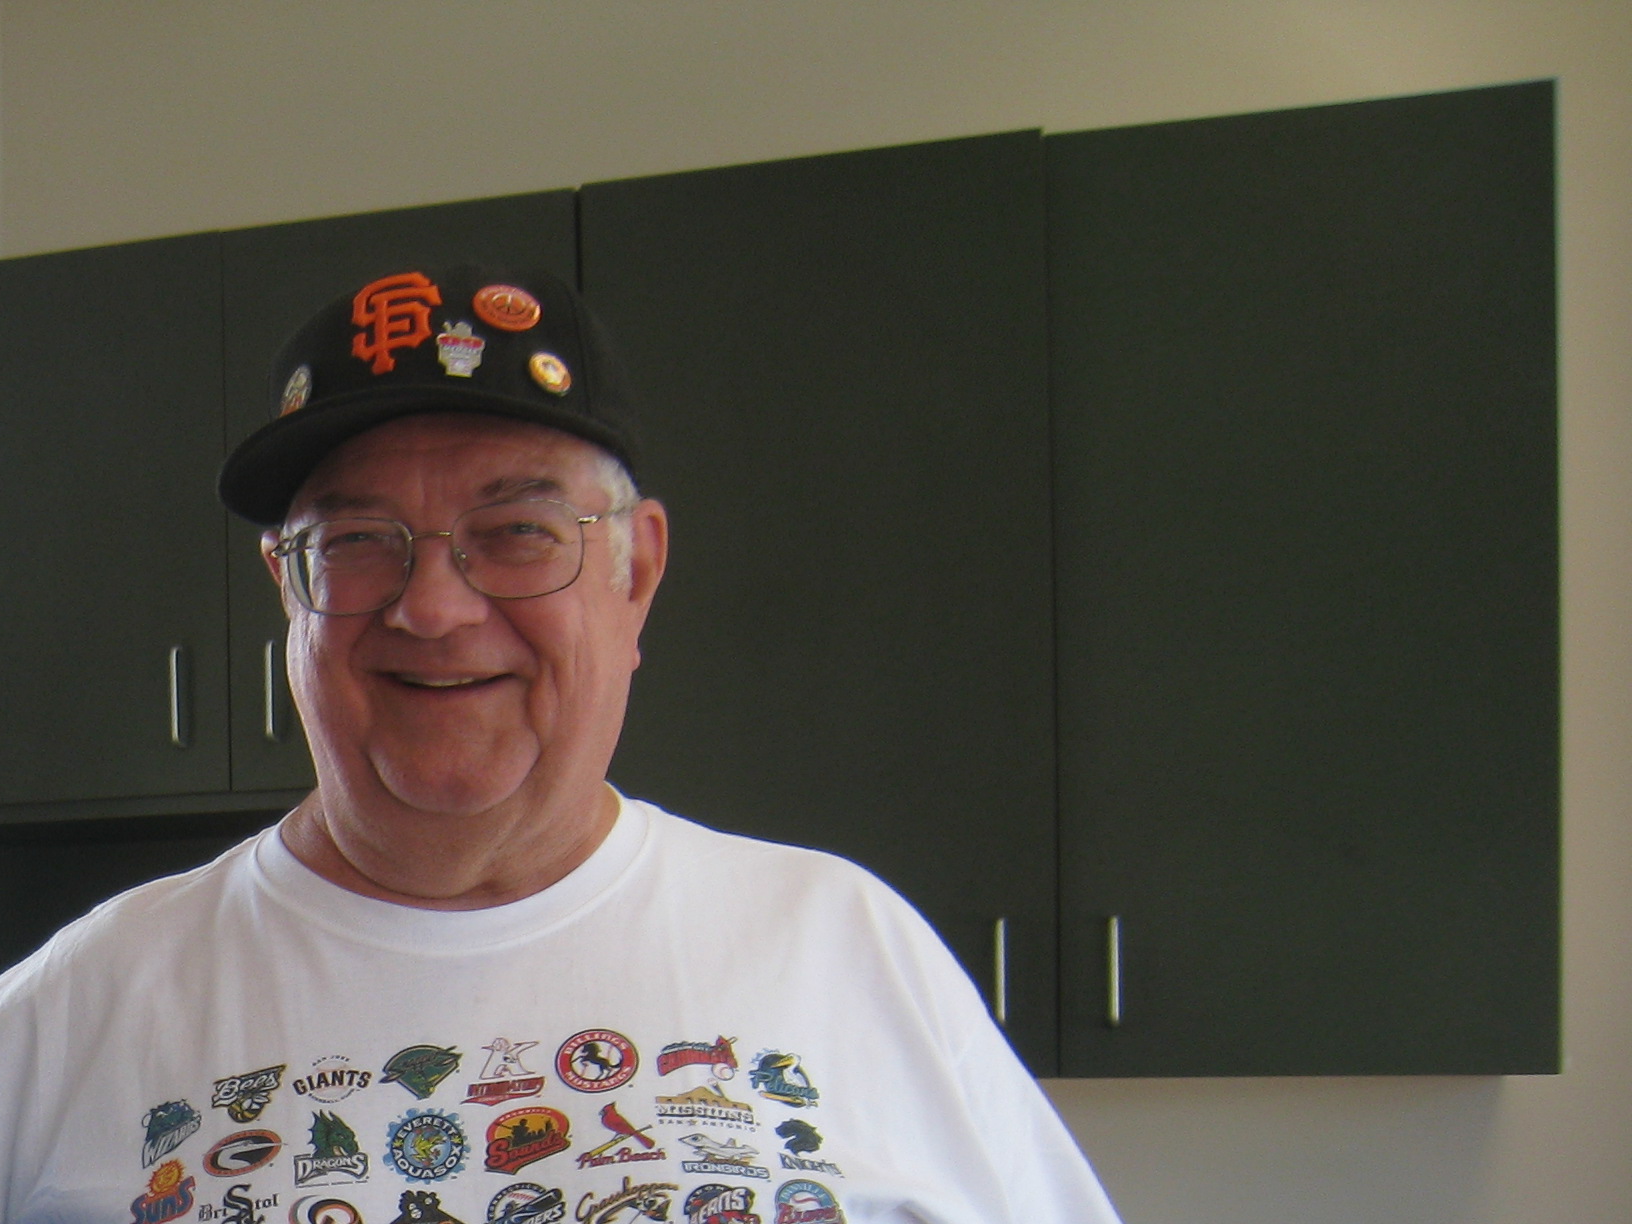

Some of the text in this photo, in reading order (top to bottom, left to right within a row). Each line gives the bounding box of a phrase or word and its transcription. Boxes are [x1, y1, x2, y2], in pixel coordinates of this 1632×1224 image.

[352, 271, 442, 376] SF
[215, 1072, 279, 1099] Bees
[292, 1070, 372, 1096] GIANTS
[398, 1116, 459, 1139] EVERETT
[295, 1152, 367, 1182] DRAGONS
[393, 1145, 462, 1179] AQUASOX
[575, 1147, 666, 1170] Palm Beach
